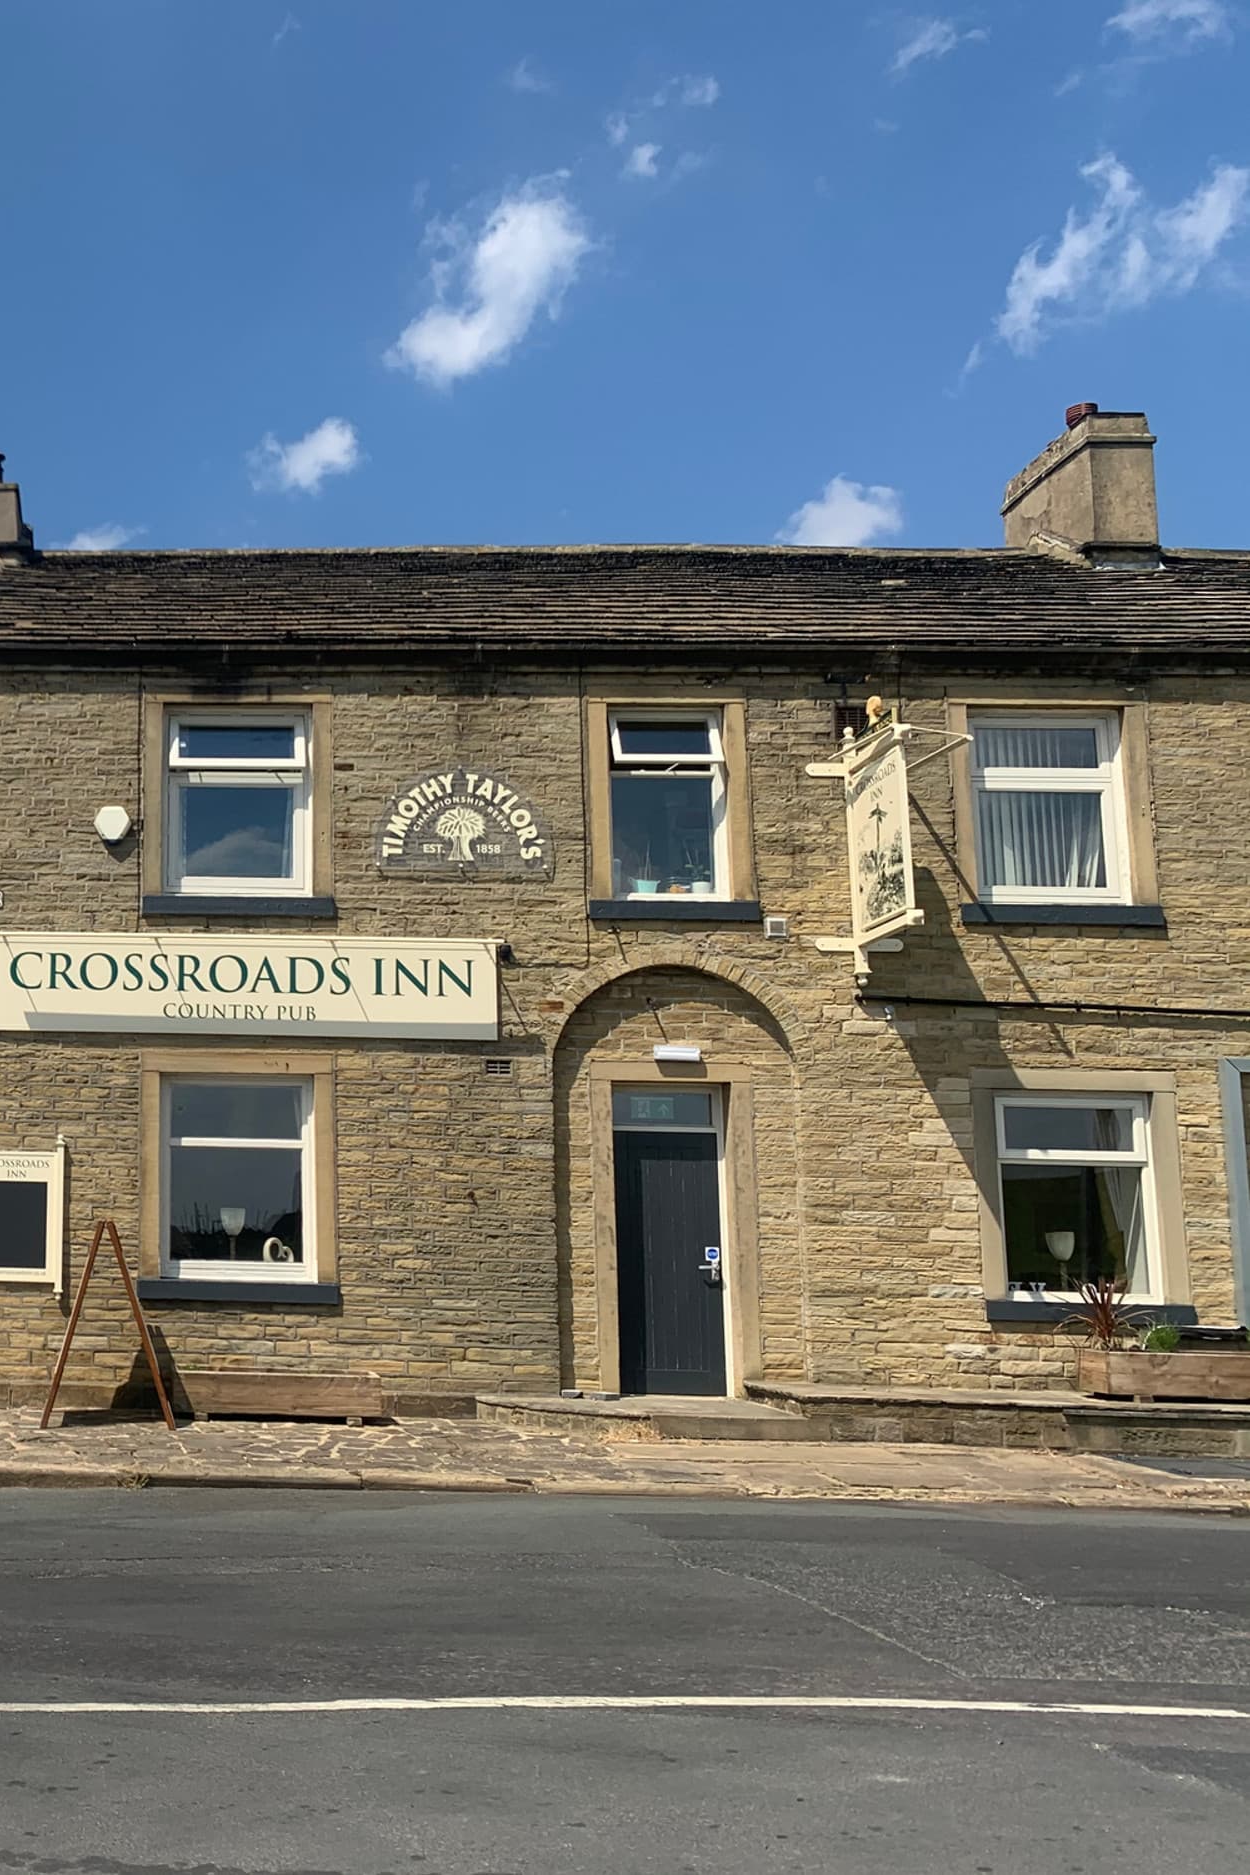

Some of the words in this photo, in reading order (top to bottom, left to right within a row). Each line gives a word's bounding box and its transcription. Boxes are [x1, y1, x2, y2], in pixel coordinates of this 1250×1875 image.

[382, 773, 455, 858] TIMOTHY
[465, 773, 546, 860] TAYLOR'S
[413, 796, 485, 832] CHAMPIONSHIP
[487, 806, 511, 833] BEERS
[423, 844, 446, 854] EST.
[476, 844, 501, 854] 1858
[9, 951, 352, 997] CROSSROADS
[370, 957, 476, 998] INN
[162, 1002, 270, 1021] COUNTRY
[276, 1005, 317, 1022] PUB
[6, 1169, 28, 1178] INN
